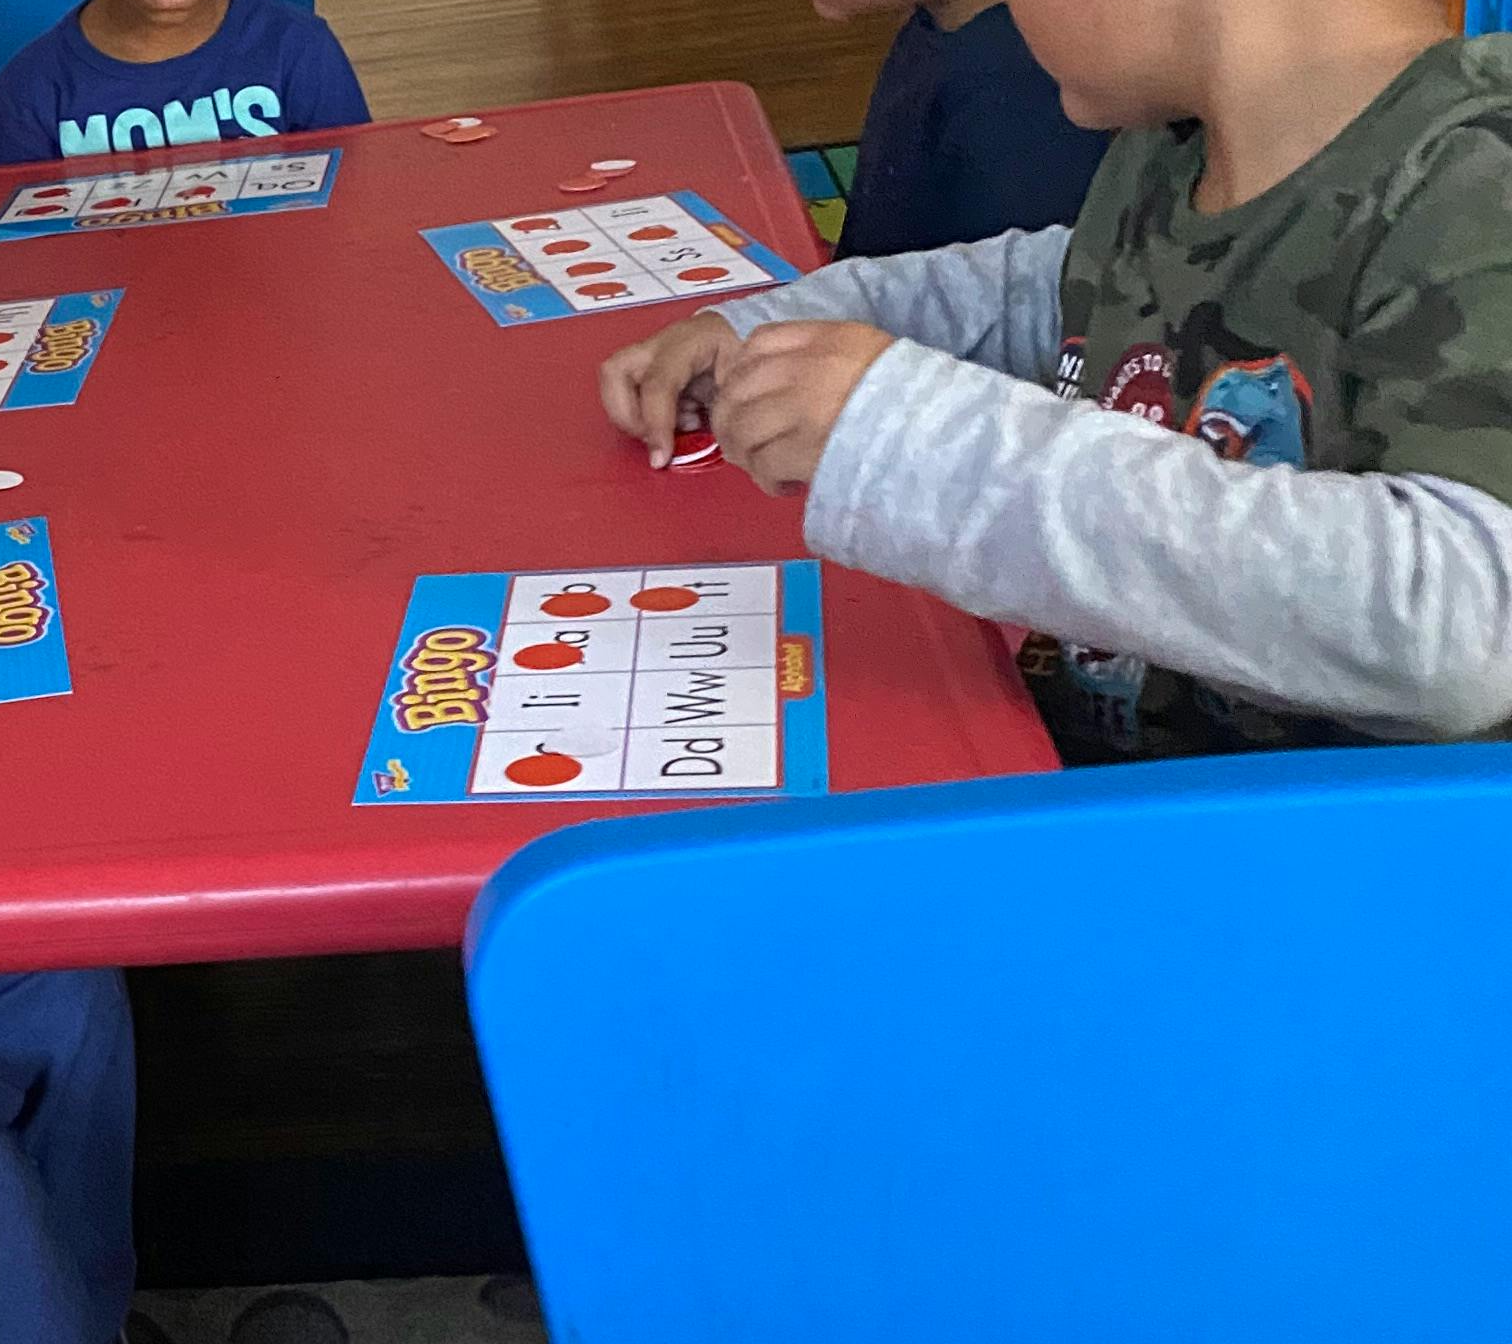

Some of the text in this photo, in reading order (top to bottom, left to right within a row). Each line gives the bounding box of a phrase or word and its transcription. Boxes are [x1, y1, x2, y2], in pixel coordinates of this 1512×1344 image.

[73, 201, 227, 229] Bingo
[461, 246, 546, 294] Bingo
[28, 319, 96, 373] Bingo
[668, 625, 730, 659] Uu
[401, 627, 491, 731] Bingo
[521, 693, 582, 708] Ii
[664, 671, 727, 725] Ww
[660, 737, 726, 777] Dd
